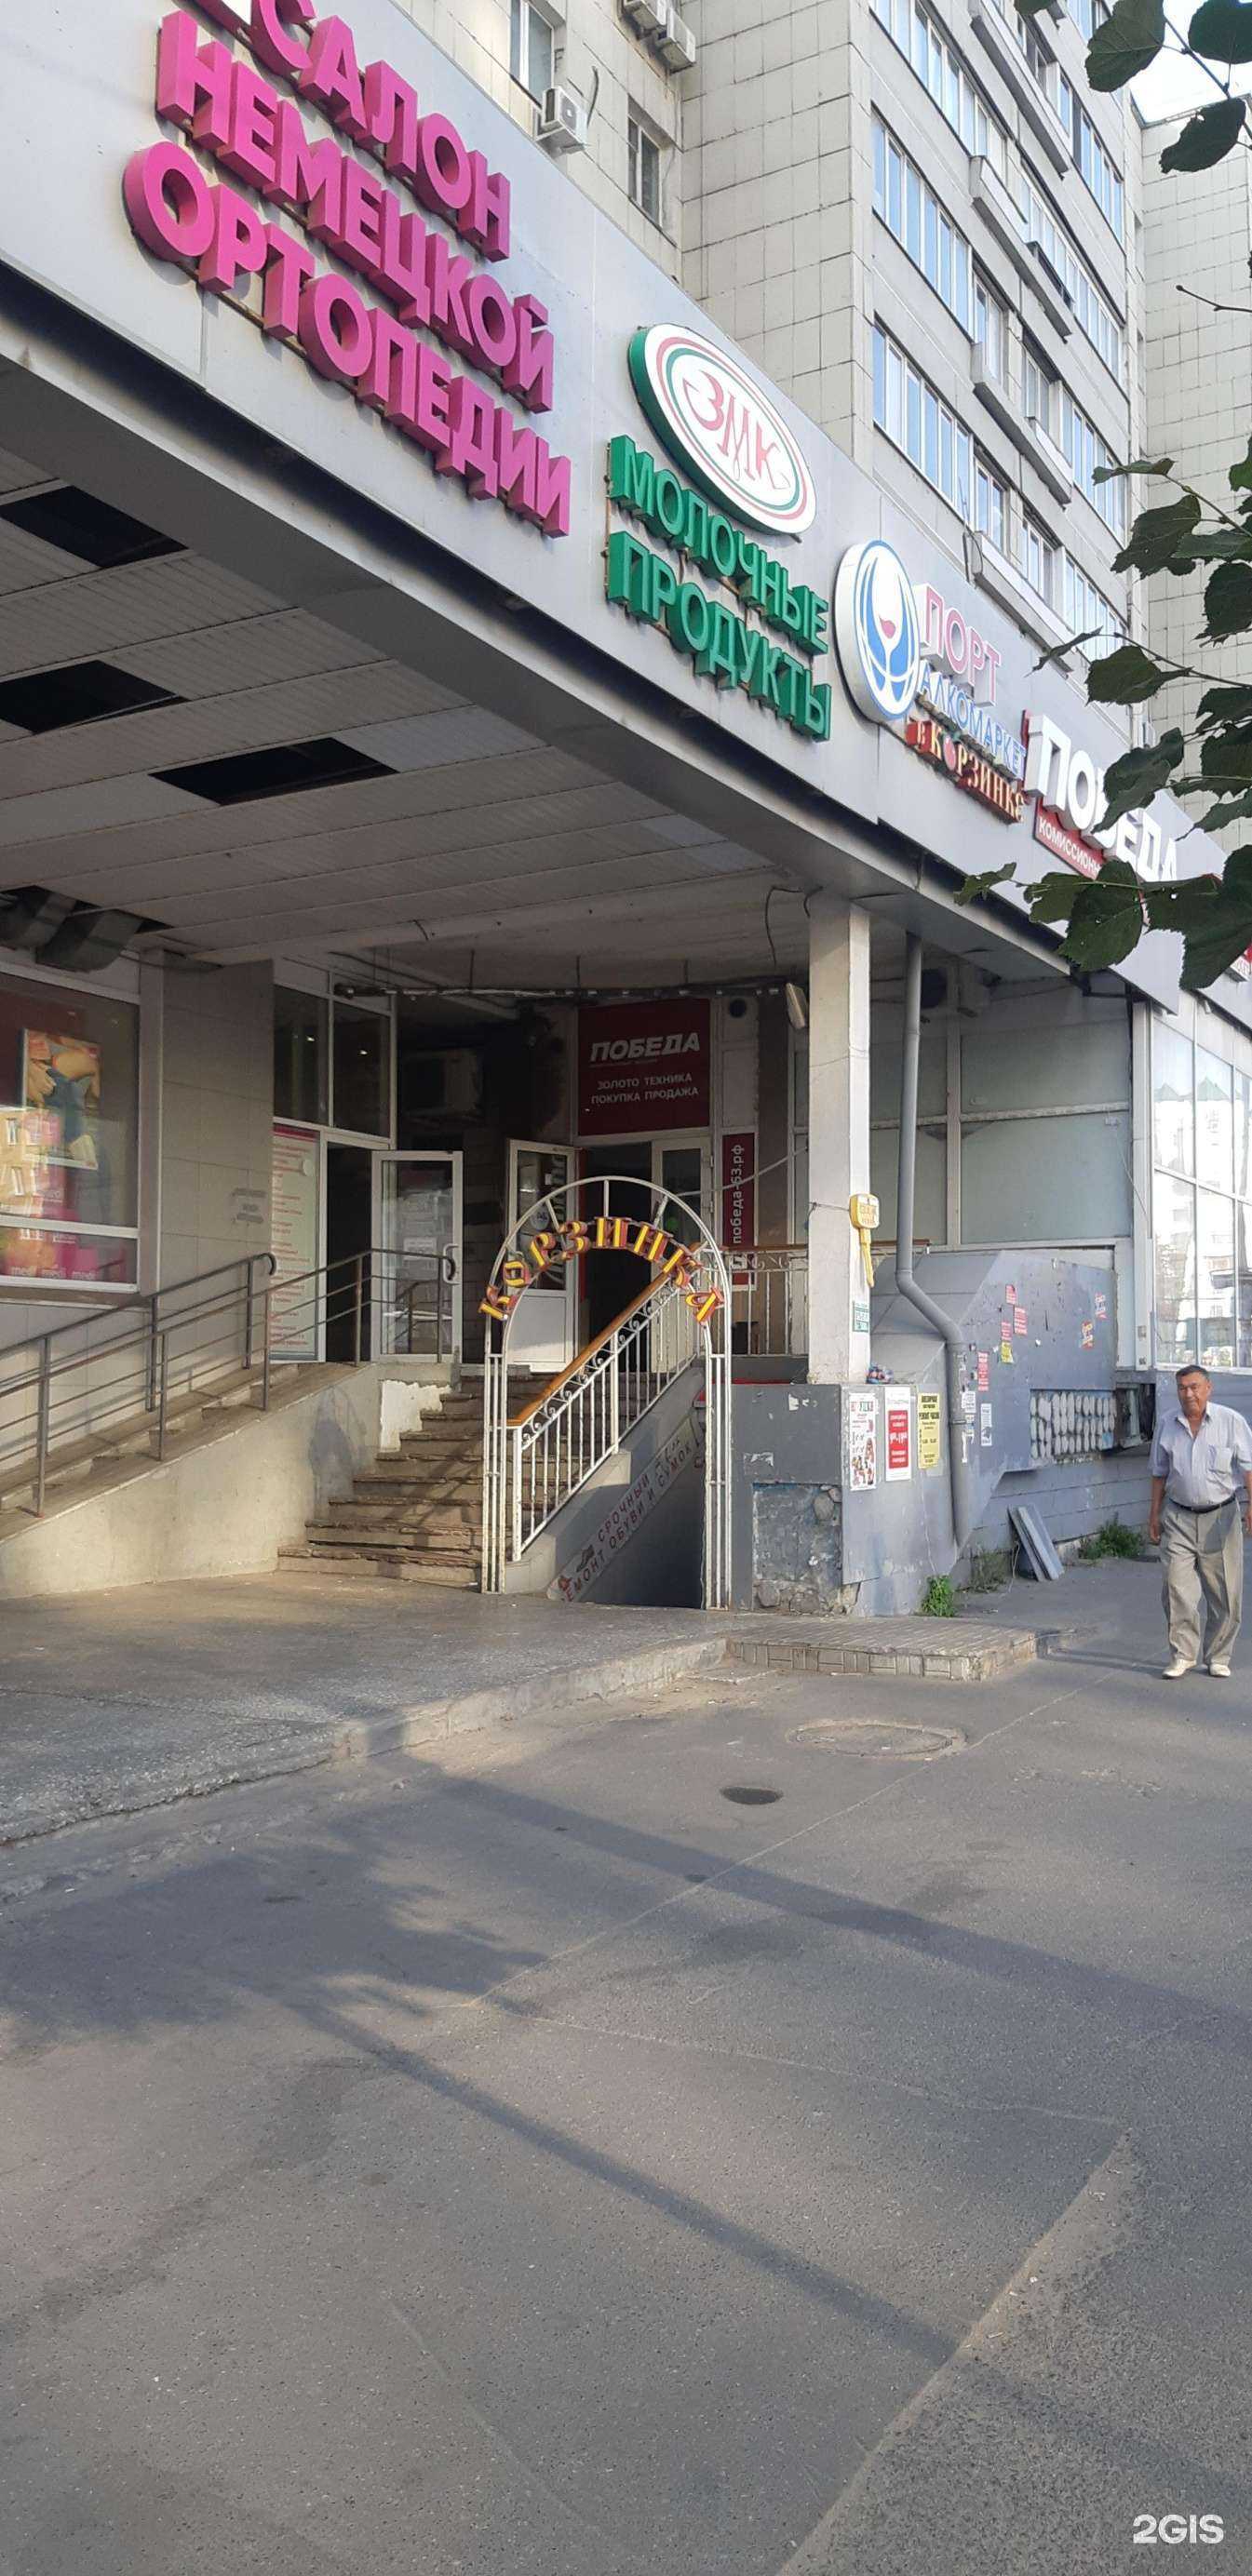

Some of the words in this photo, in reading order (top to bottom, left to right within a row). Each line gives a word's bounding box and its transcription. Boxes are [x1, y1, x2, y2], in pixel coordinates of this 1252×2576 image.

[251, 0, 510, 262] САЛОН
[156, 10, 554, 413] НЕМЕЦКОЙ
[125, 141, 572, 538] ОРТОПЕДИИ
[682, 369, 791, 490] ЗМК
[611, 434, 828, 655] МОЛОЧНЫЕ
[609, 530, 831, 742] ПРОДУКТЫ
[918, 584, 1002, 707] ПОРТ
[917, 659, 1027, 781] АЛКОМАРКЕТ
[590, 1032, 700, 1062] ПОБЕДА
[591, 1093, 640, 1105] ПОКУПКА
[644, 1086, 699, 1101] ПРОДАЖА
[598, 1077, 639, 1091] ЗОЛОТО
[644, 1072, 693, 1086] ТЕХНИКА
[731, 1144, 745, 1244] победа-63.рф
[561, 1548, 606, 1603] ЕМОНТ
[609, 1502, 645, 1550] ОБУВИ
